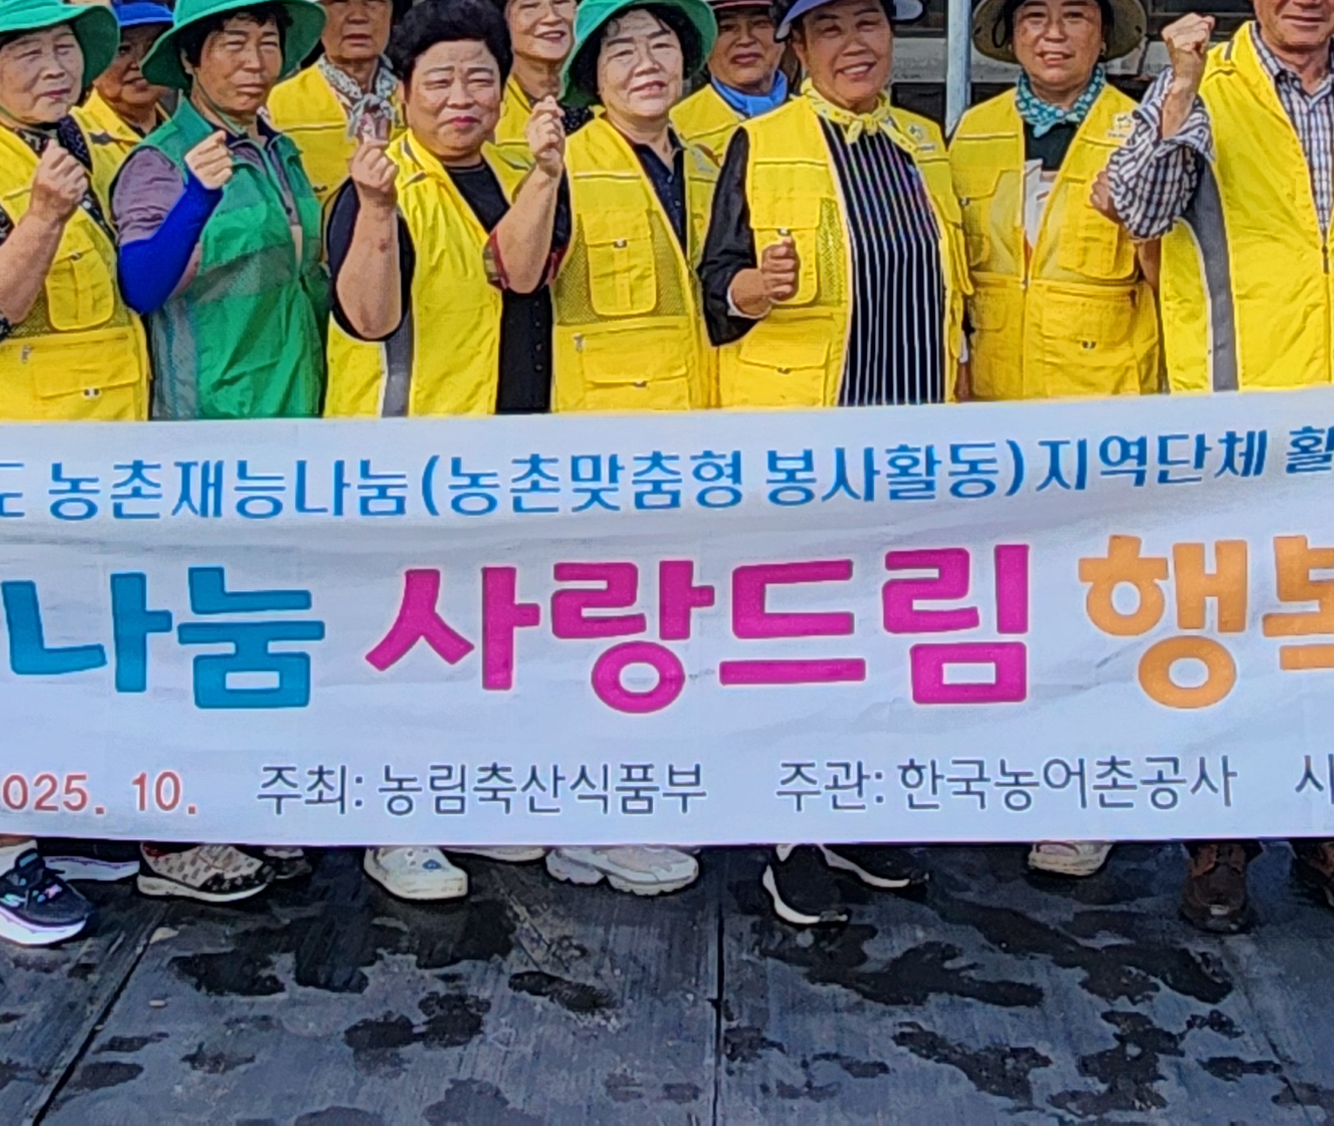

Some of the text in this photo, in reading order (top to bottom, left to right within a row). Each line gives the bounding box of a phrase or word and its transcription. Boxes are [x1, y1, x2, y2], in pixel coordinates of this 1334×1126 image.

[49, 450, 743, 520] 농촌재능나눔(농촌맞춤형
[366, 544, 1029, 712] 사랑드림
[134, 771, 198, 814] 10.
[257, 763, 708, 816] 주최: 농림축산식품부
[776, 756, 1238, 812] 주관: 한국농어촌공사
